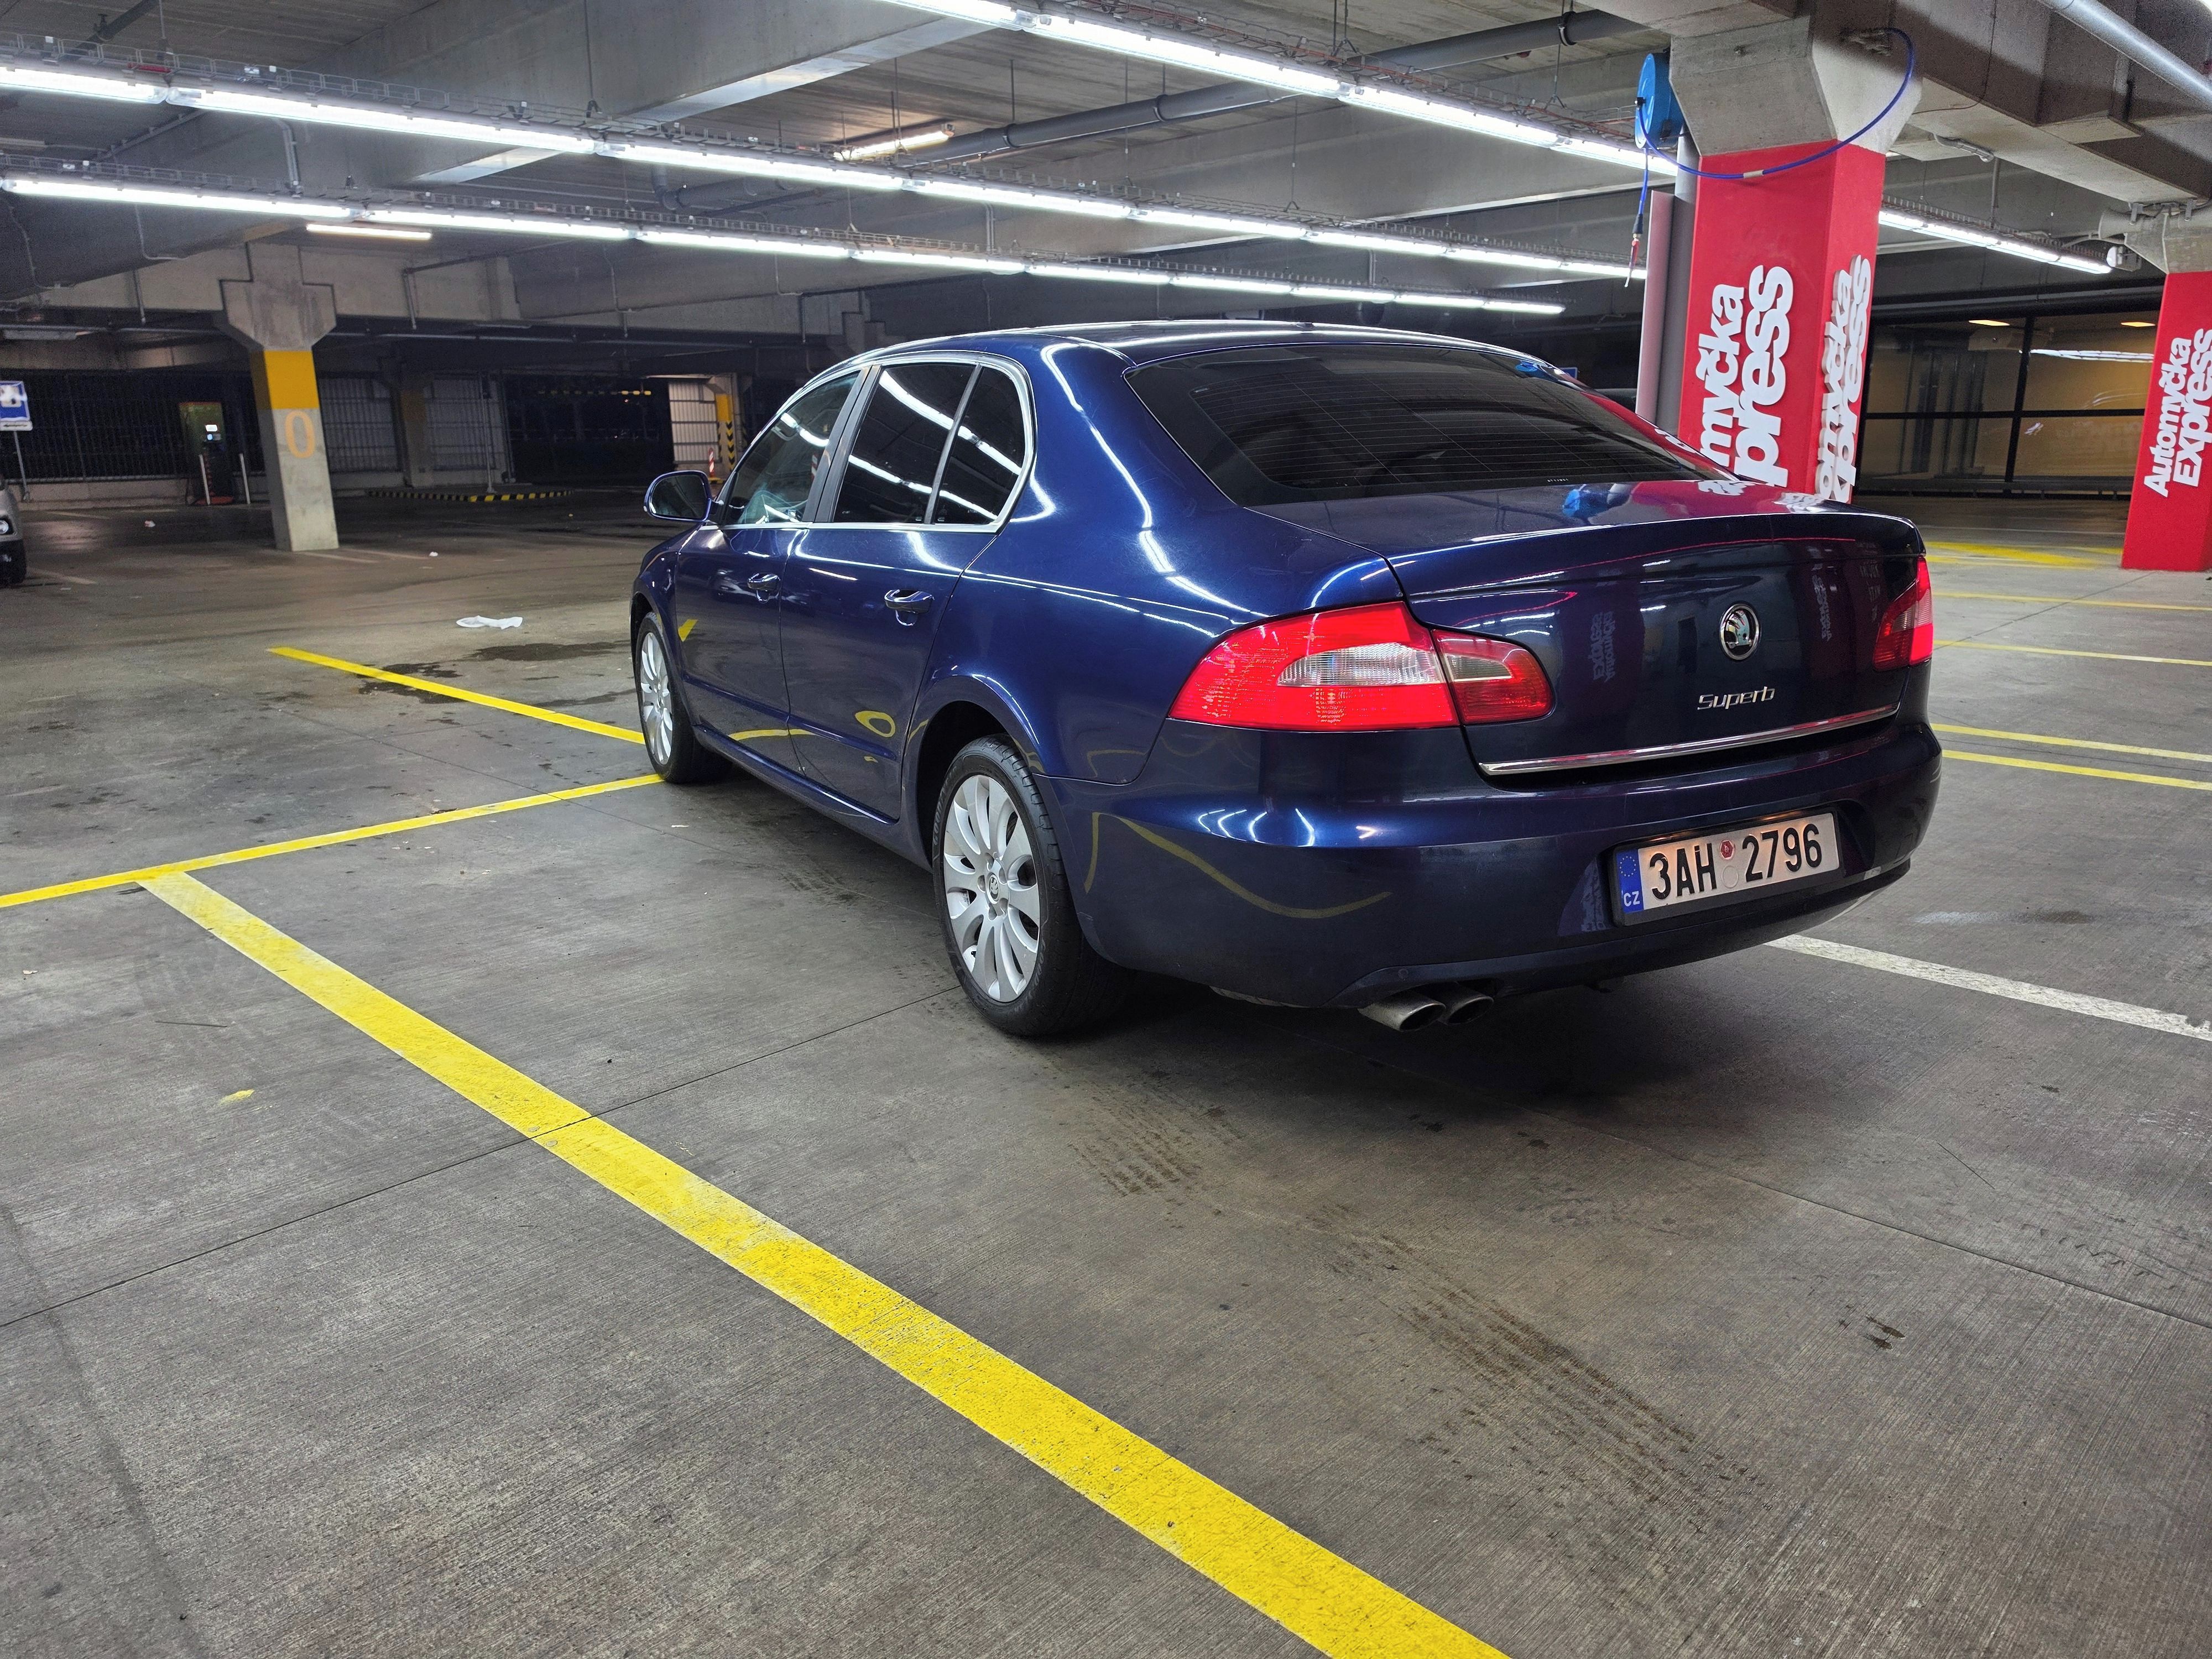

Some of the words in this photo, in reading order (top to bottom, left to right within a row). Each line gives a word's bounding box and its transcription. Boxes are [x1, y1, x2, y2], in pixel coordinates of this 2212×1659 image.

[1695, 284, 1744, 467] myčka
[1734, 265, 1793, 488] press
[1815, 270, 1852, 499] omyčka
[1832, 254, 1871, 503] xpress
[2144, 337, 2192, 498] Automyčka
[2173, 328, 2212, 487] Express
[1697, 686, 1776, 711] Superb
[1623, 890, 1641, 907] CZ
[1649, 842, 1717, 900] 3AH
[1741, 823, 1823, 883] 2796
